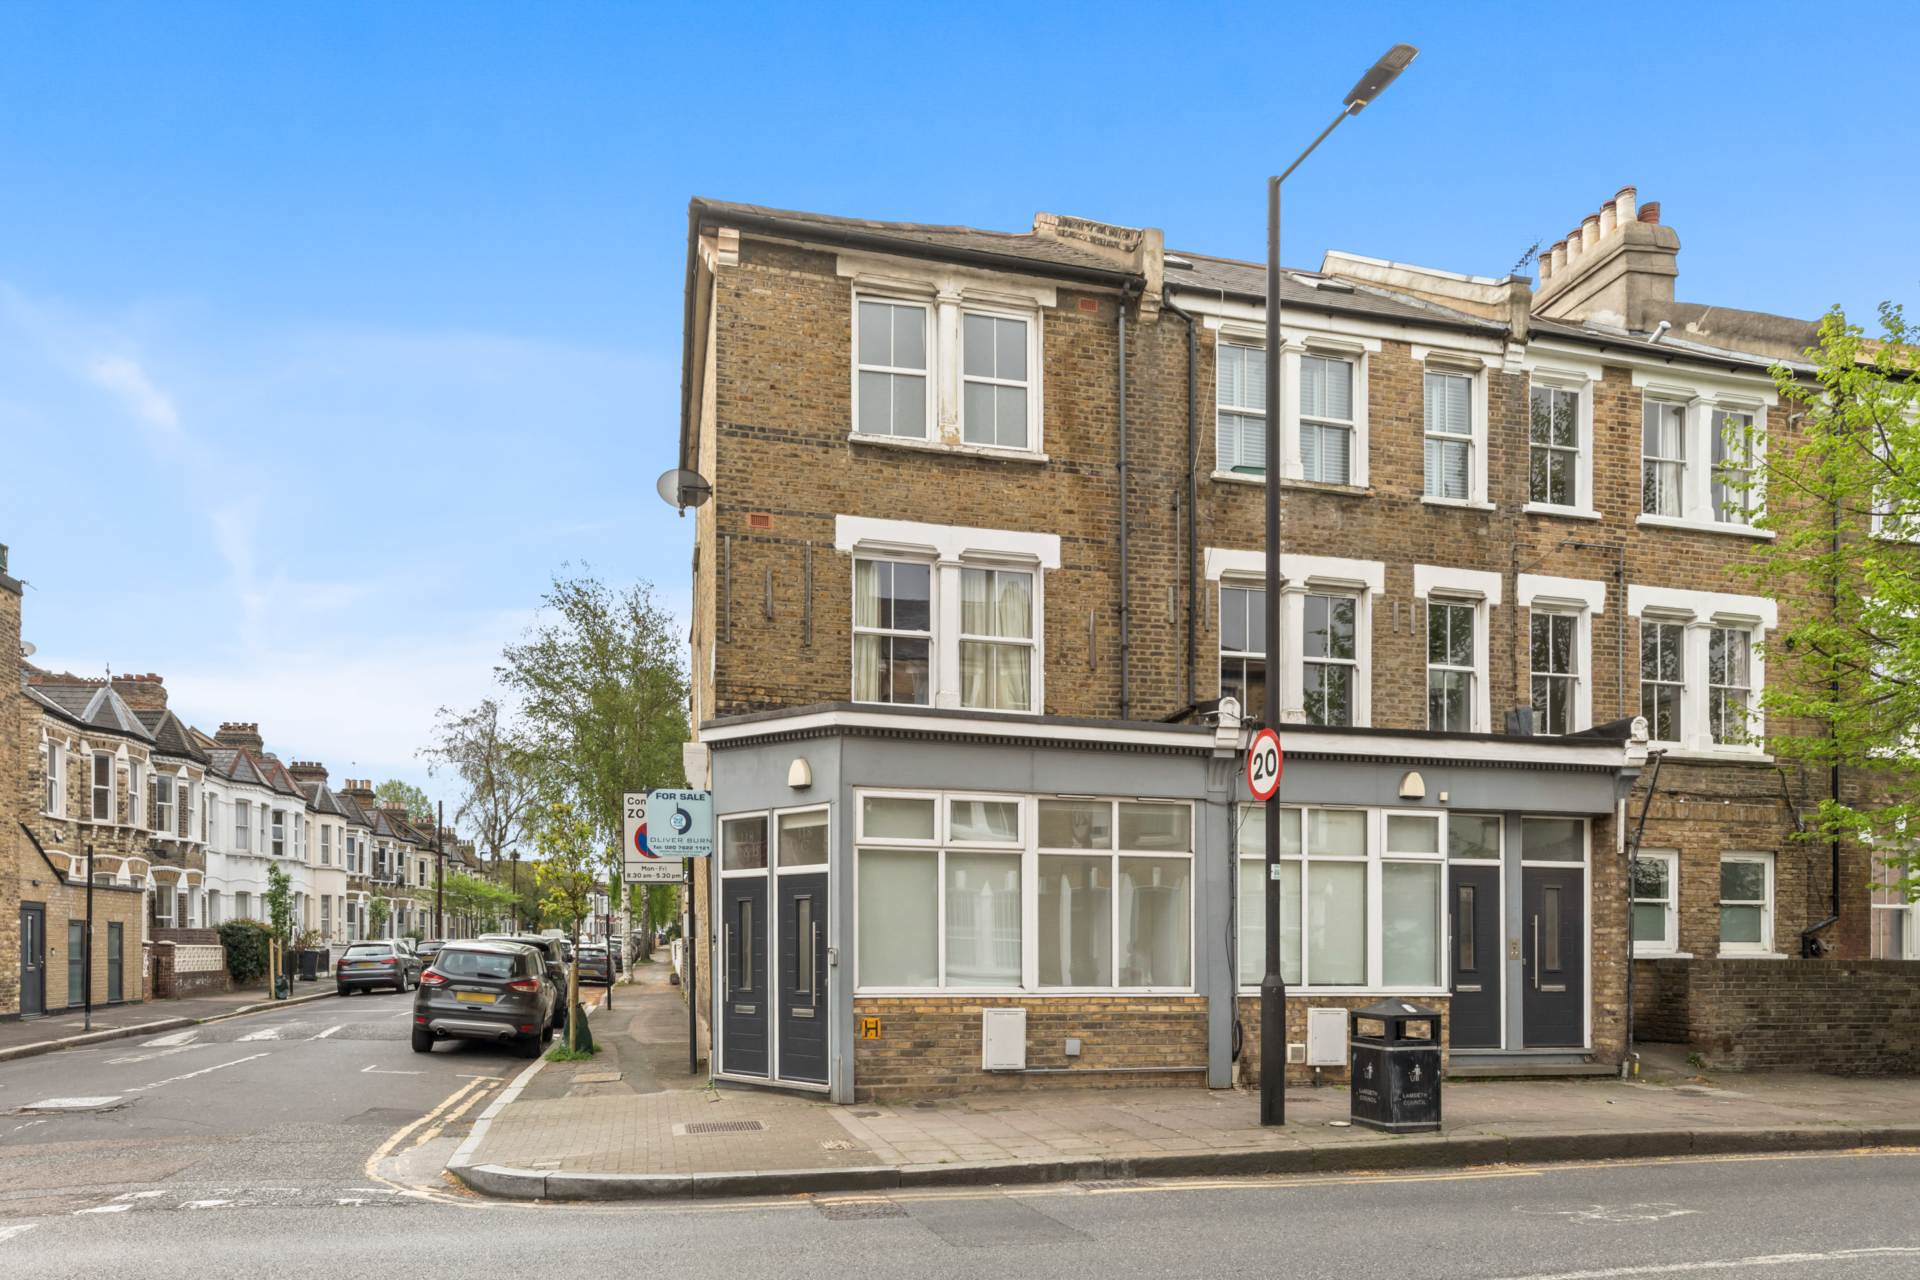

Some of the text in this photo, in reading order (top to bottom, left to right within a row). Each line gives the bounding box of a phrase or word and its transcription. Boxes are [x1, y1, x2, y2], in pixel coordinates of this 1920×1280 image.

[1253, 748, 1277, 781] 20
[655, 792, 705, 801] FOR SALE
[864, 1020, 878, 1037] H
